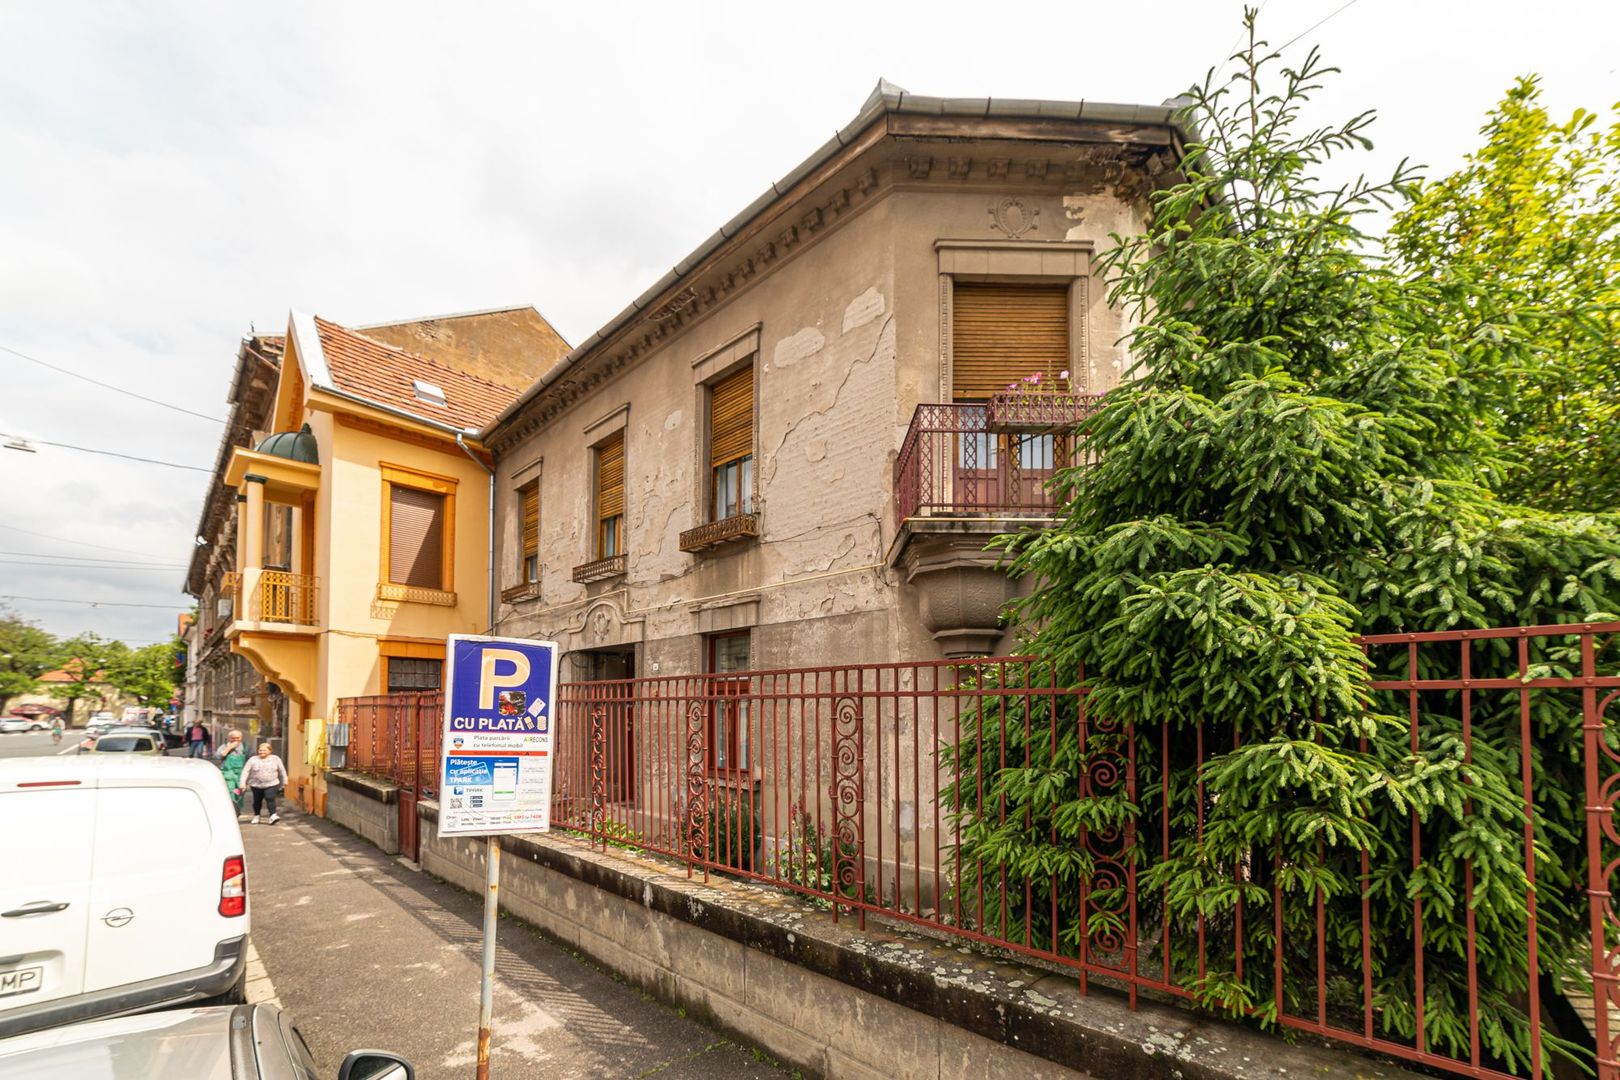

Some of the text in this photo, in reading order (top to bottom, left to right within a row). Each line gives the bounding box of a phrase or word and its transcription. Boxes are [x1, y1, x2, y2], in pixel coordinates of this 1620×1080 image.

[478, 647, 531, 710] P
[454, 716, 526, 731] CU PLATĂ
